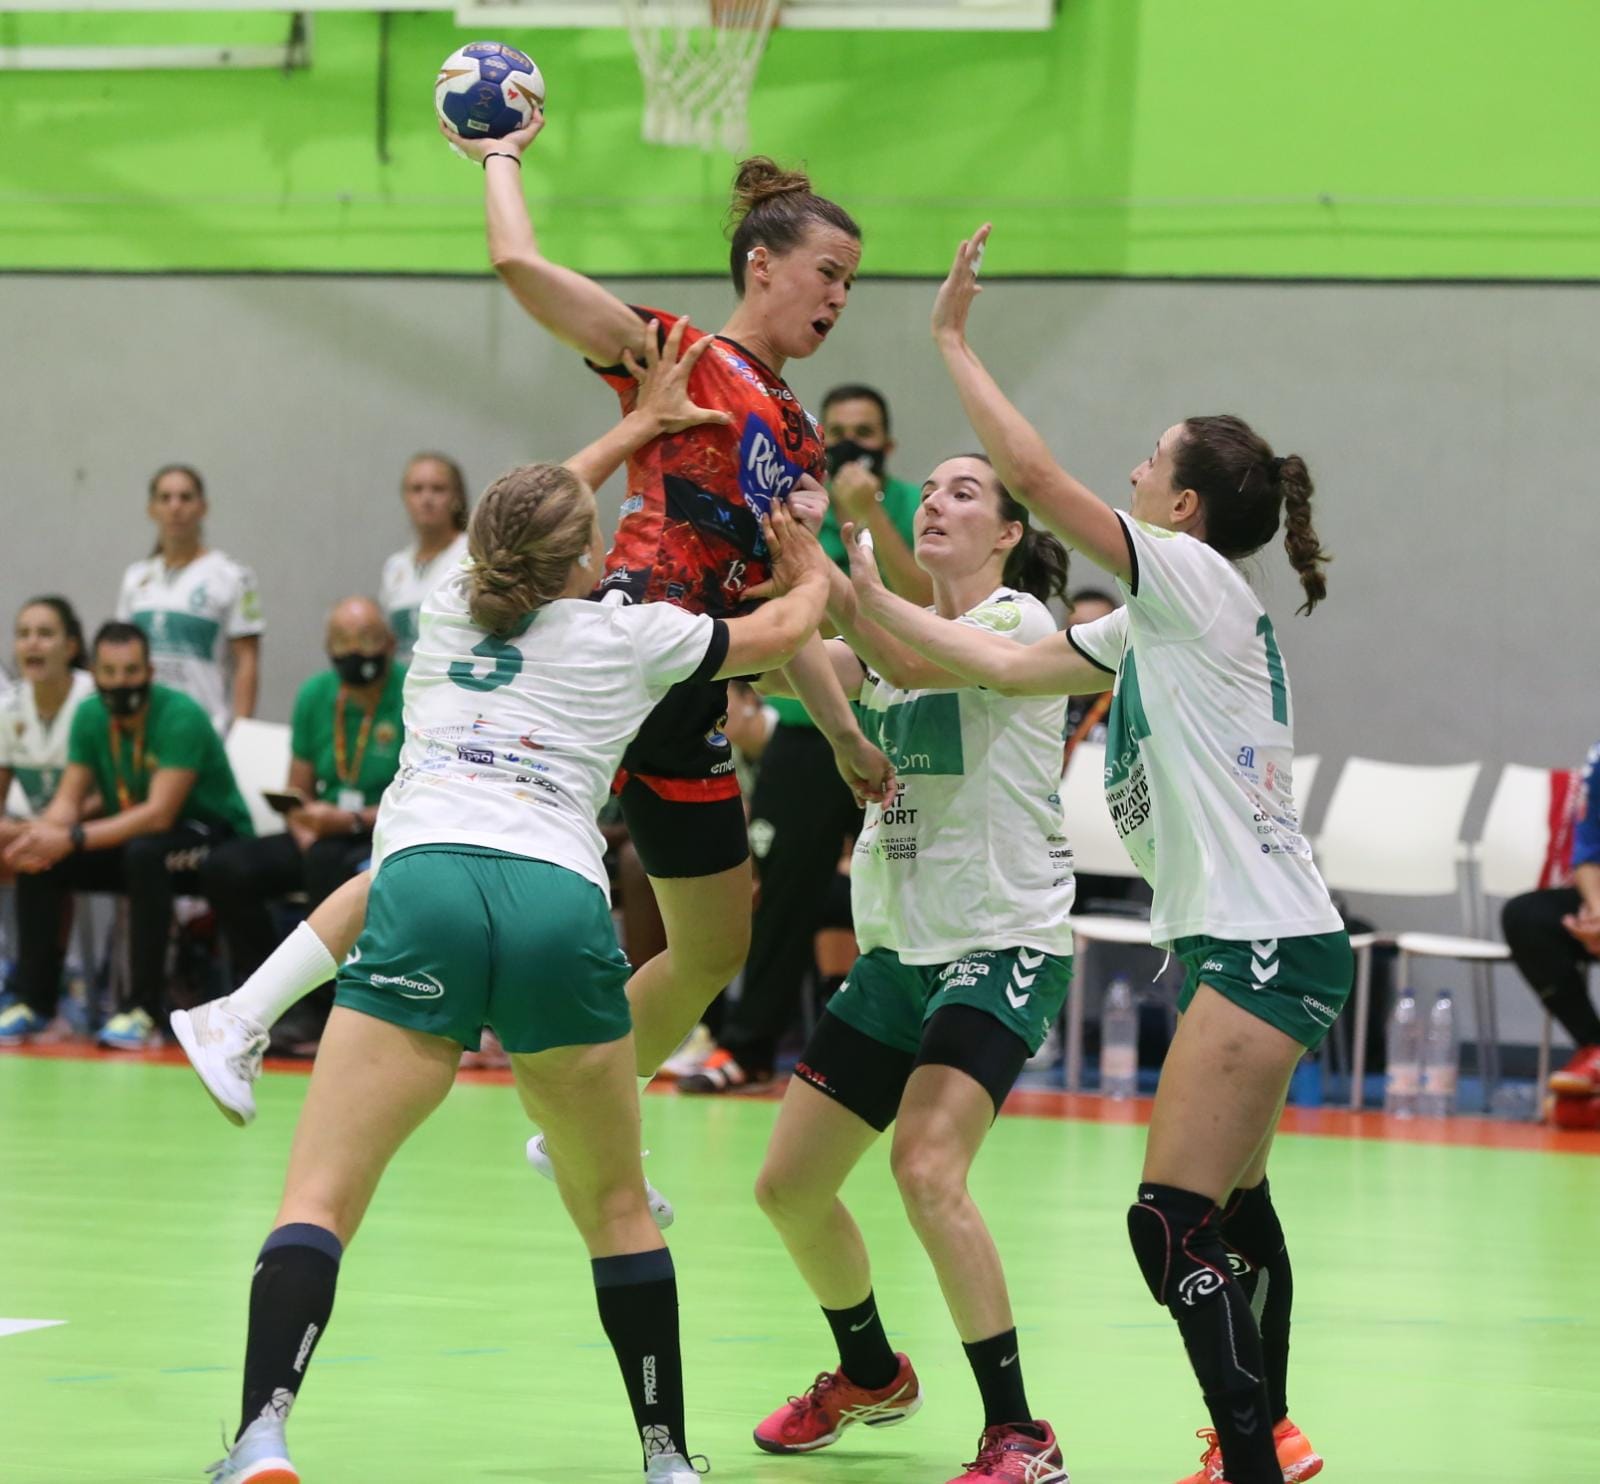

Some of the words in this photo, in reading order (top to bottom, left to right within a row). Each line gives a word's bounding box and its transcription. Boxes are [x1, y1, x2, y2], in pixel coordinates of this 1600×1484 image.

[783, 406, 804, 451] 9
[292, 1323, 318, 1373] PROZIS
[642, 1355, 658, 1405] PROZIS
